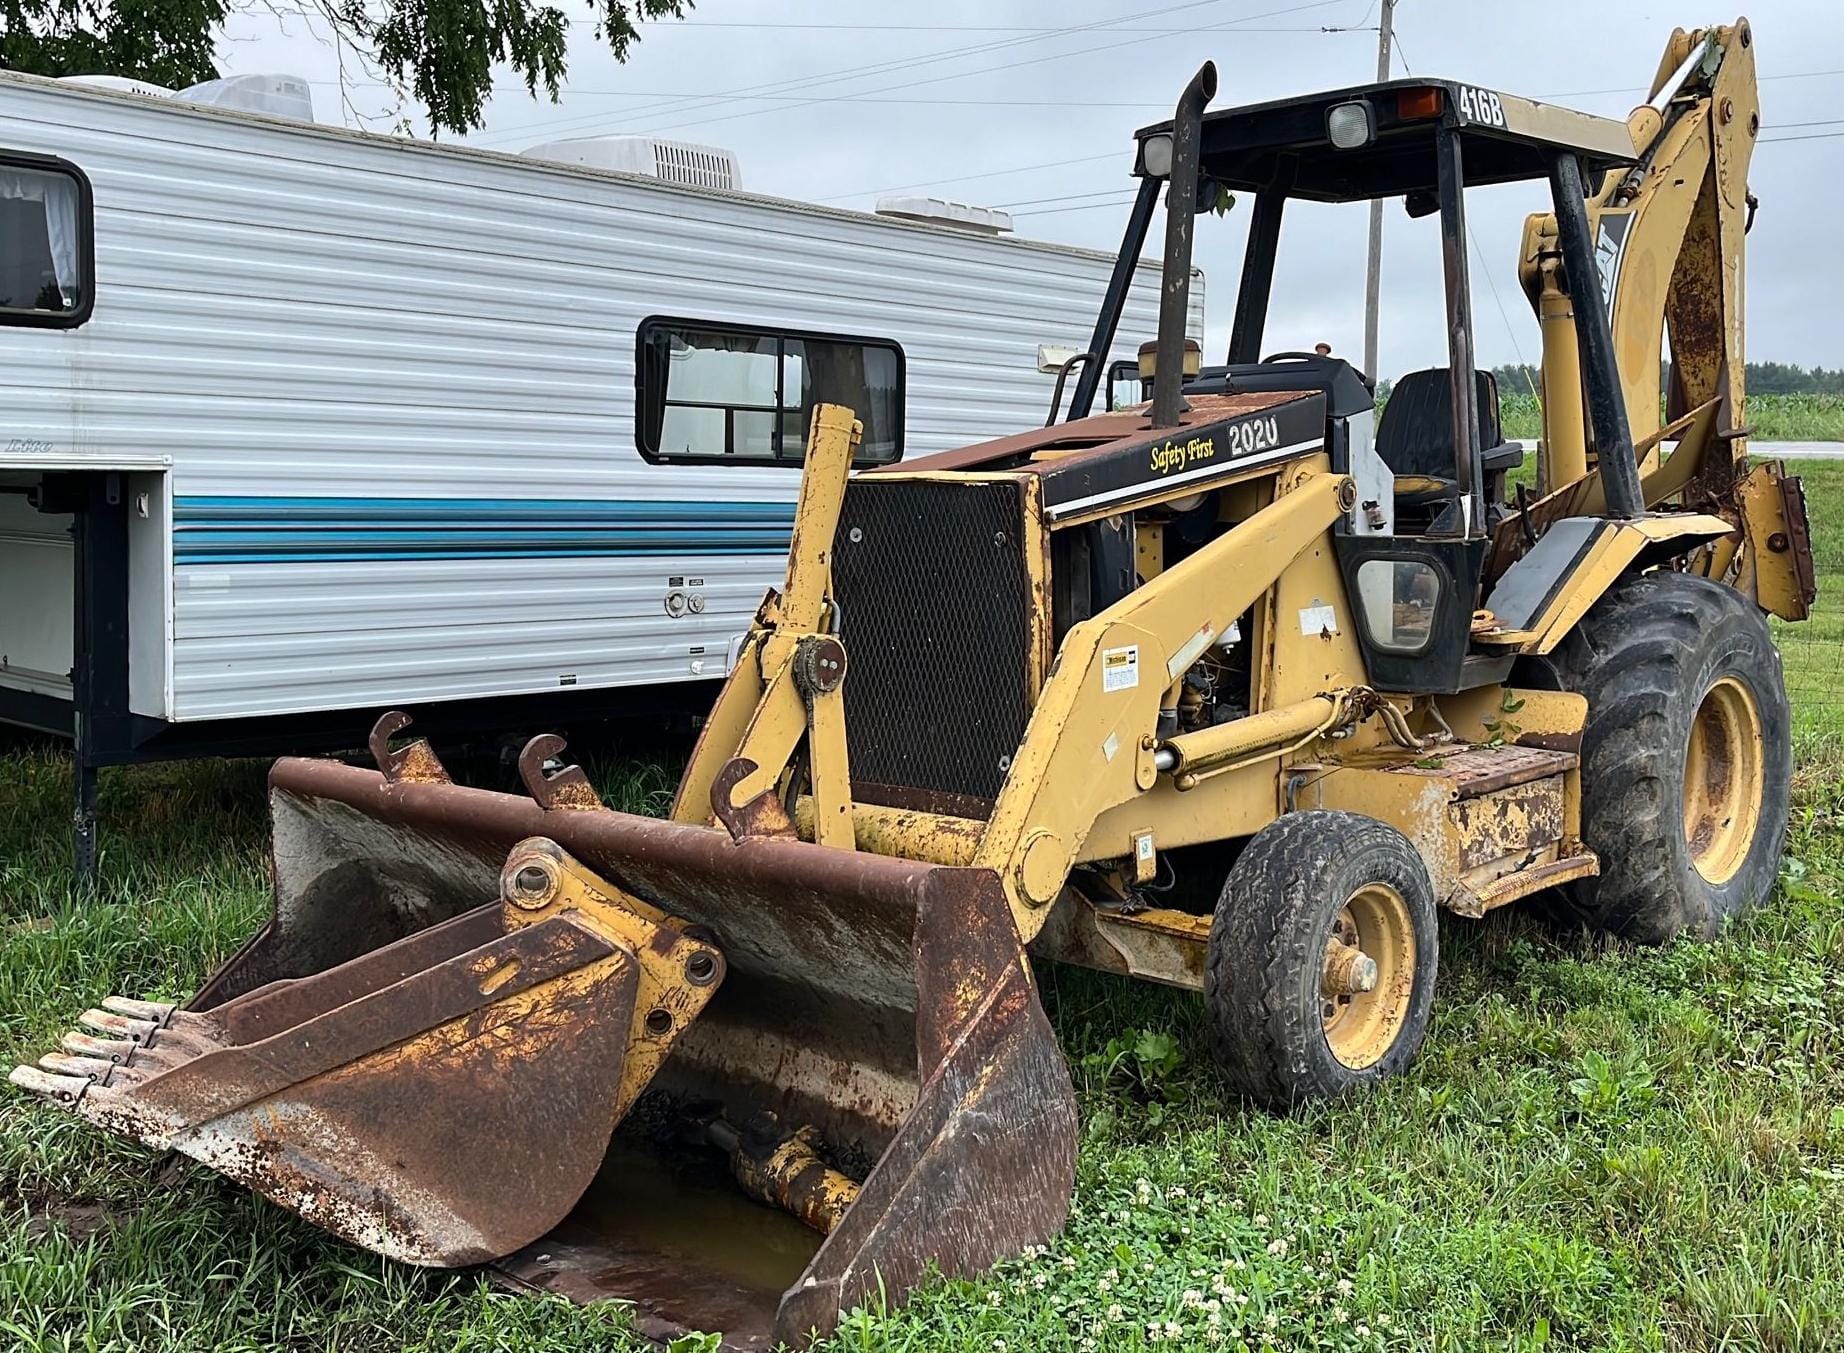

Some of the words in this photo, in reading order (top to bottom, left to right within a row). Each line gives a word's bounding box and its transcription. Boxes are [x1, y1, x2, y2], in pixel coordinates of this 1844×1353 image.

[1460, 86, 1503, 126] 416B
[1150, 441, 1186, 474] Safety
[1188, 437, 1214, 462] First
